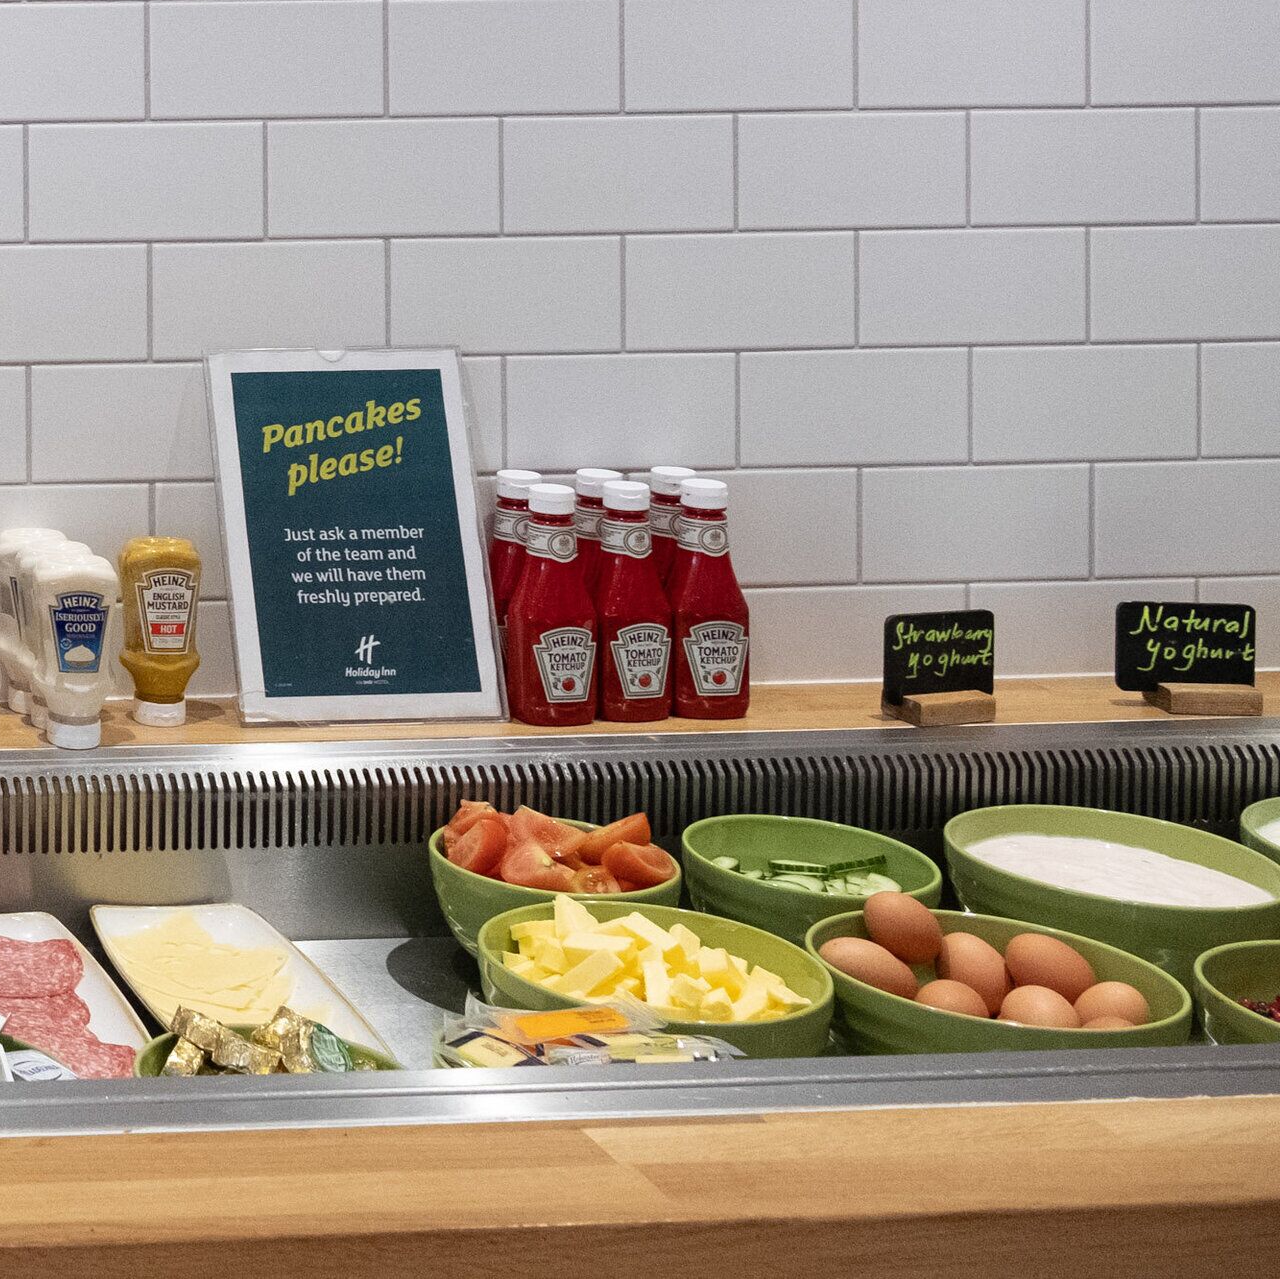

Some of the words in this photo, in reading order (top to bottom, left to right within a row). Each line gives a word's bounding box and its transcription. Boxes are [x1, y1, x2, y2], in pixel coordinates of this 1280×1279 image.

[262, 398, 422, 454] Pancakes
[288, 436, 404, 496] please!
[284, 528, 316, 541] Just
[319, 526, 346, 540] ask
[349, 529, 358, 540] a
[361, 525, 424, 540] member
[297, 548, 312, 562] of
[316, 547, 341, 561] the
[344, 547, 384, 561] team
[388, 545, 417, 560] and
[291, 571, 313, 583] we
[316, 568, 343, 582] will
[347, 568, 383, 582] have
[386, 567, 426, 581] them
[152, 576, 186, 587] HEINZ
[62, 596, 98, 608] HEINZ
[152, 592, 185, 601] ENGLISH
[297, 589, 350, 607] freshly
[354, 587, 426, 606] prepared.
[147, 601, 189, 610] MUSTARD
[64, 622, 96, 633] GOOD
[1129, 605, 1251, 639] Natural
[160, 624, 178, 634] HOT
[701, 629, 736, 641] HEINZ
[551, 635, 585, 648] HEINZ
[628, 632, 660, 644] HEINZ
[548, 651, 587, 663] TOMATO
[625, 648, 663, 659] TOMATO
[697, 646, 739, 657] TOMATO
[550, 662, 585, 671] KETCHUP
[627, 659, 661, 667] KETCHUP
[700, 656, 737, 665] KETCHUP
[345, 666, 380, 679] Holiday
[381, 666, 397, 677] Inn
